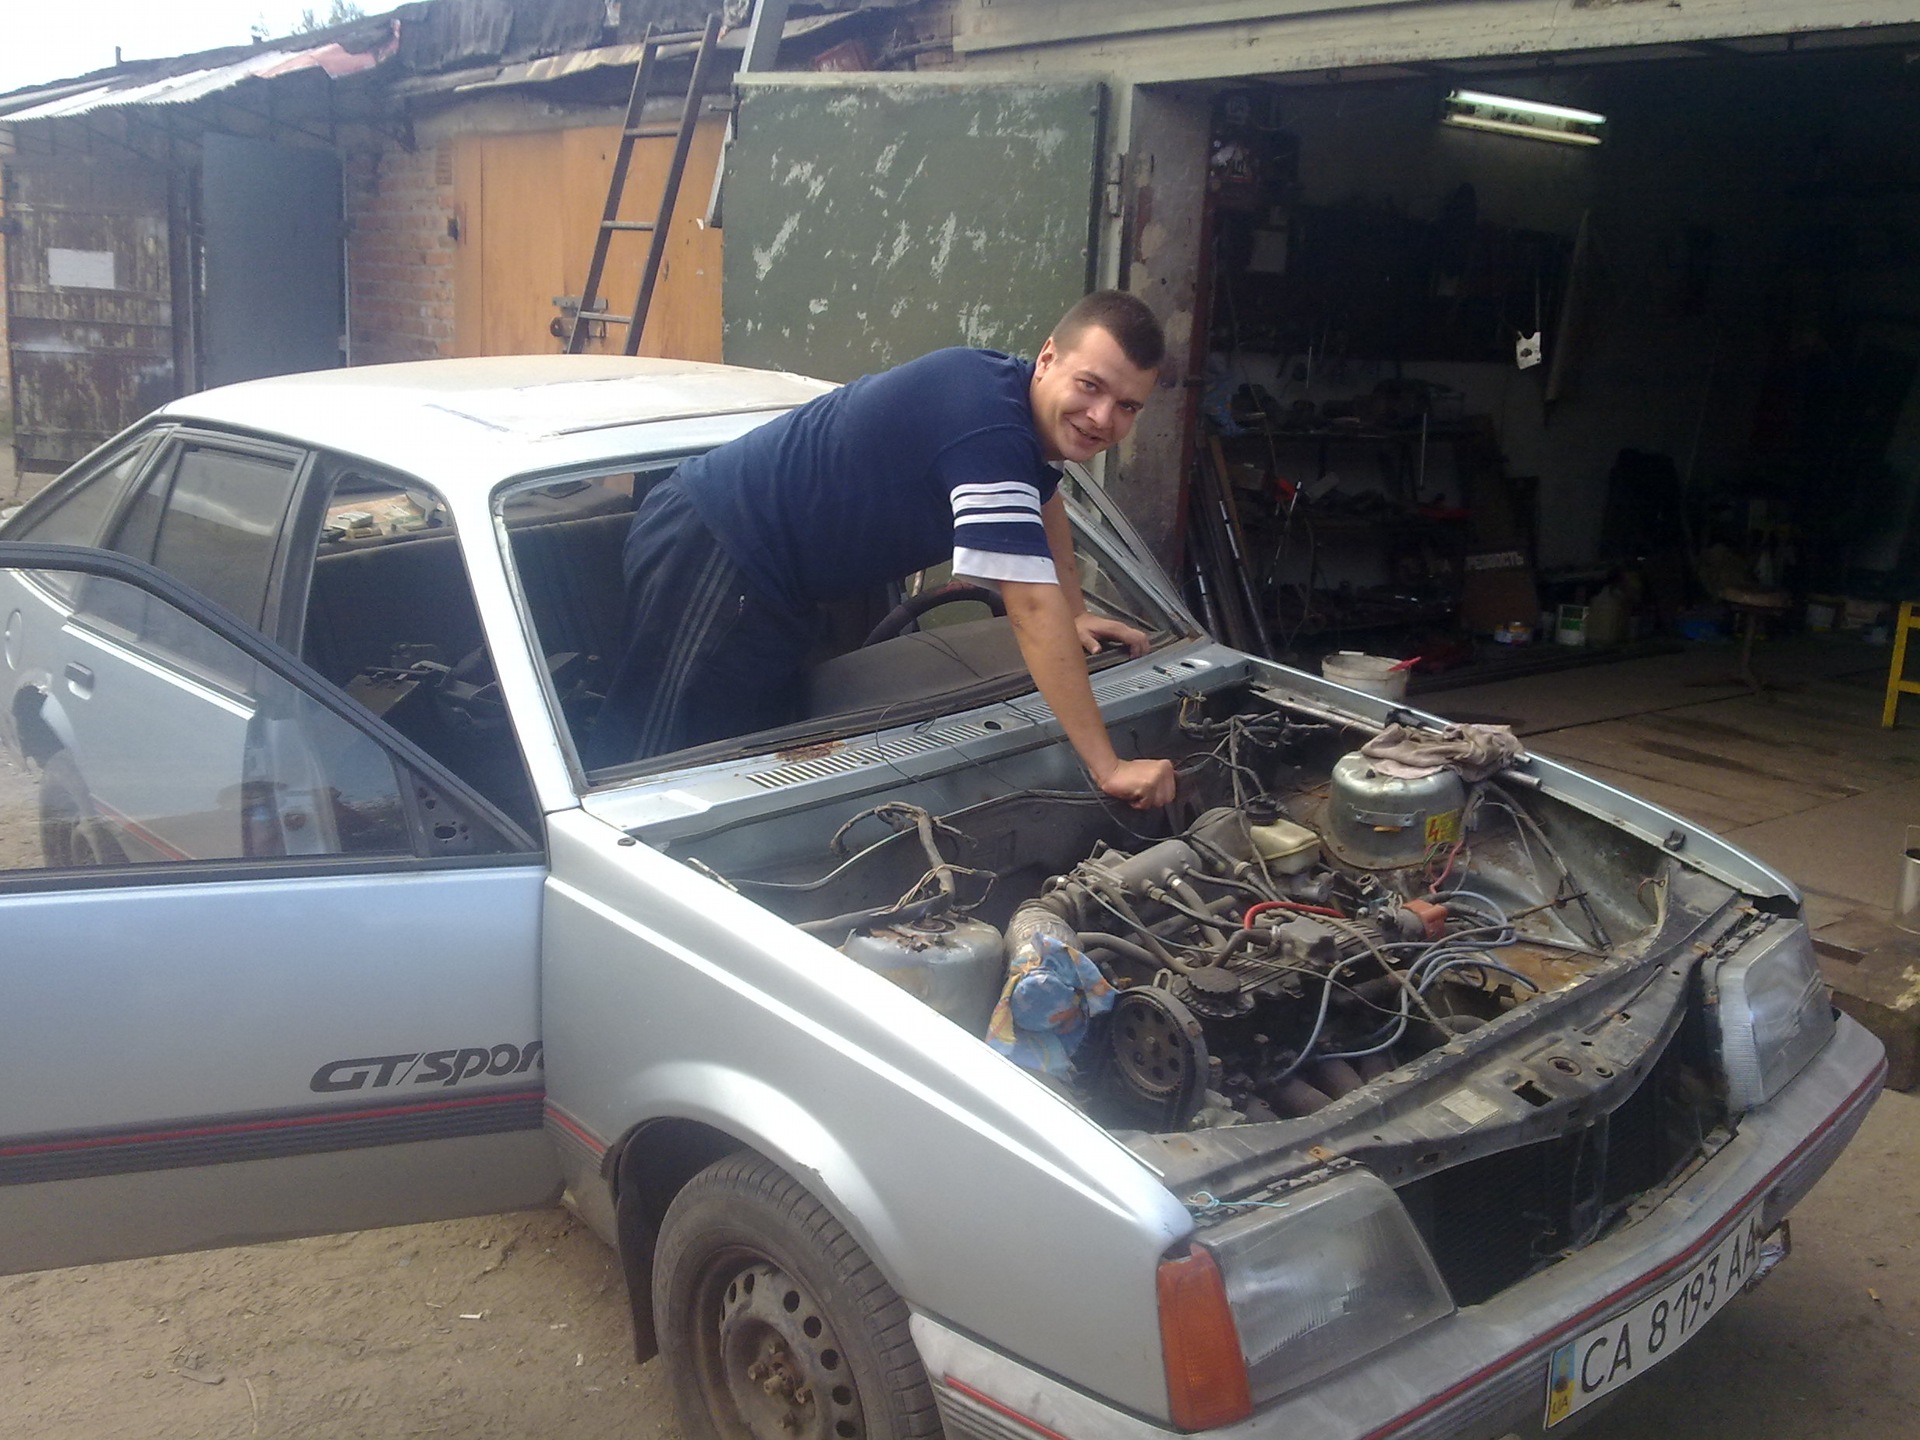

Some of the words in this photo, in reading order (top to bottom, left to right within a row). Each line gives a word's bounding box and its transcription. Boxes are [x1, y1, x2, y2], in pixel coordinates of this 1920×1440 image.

[1581, 1322, 1632, 1394] CA
[1648, 1253, 1720, 1354] 8193
[1726, 1216, 1757, 1292] AA
